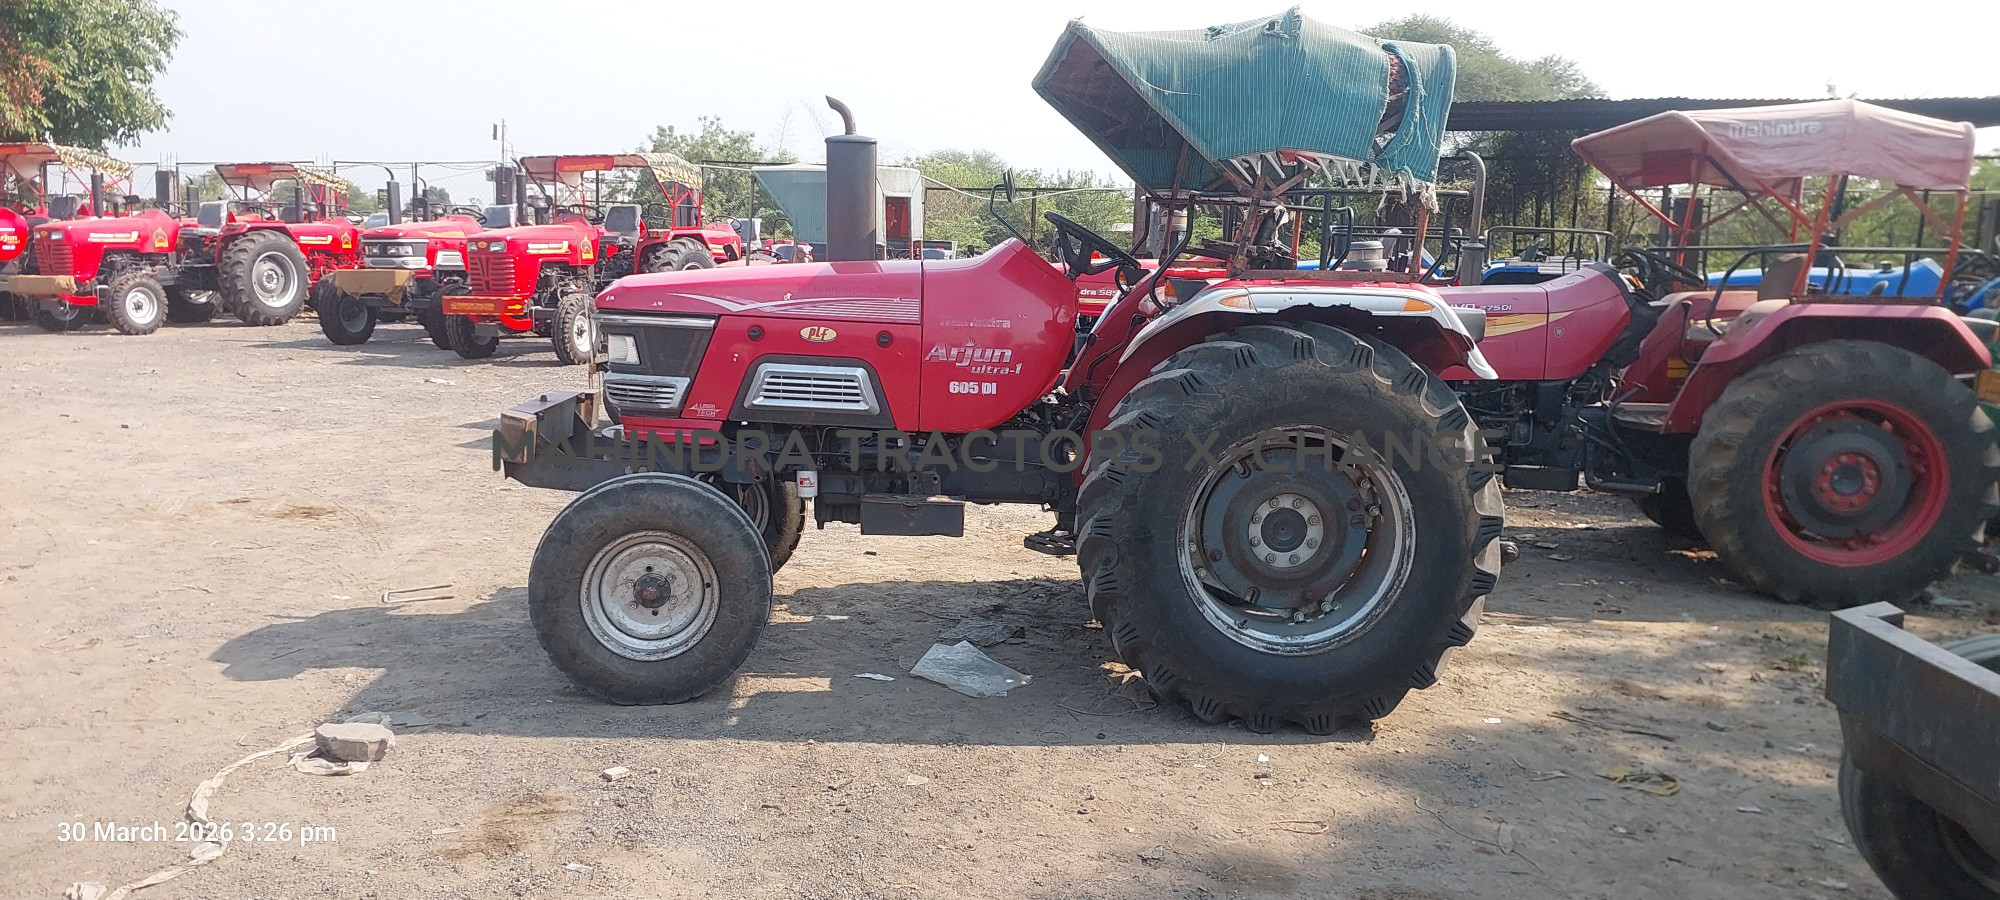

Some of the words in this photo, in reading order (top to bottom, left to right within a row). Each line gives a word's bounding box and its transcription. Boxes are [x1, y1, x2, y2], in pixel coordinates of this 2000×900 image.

[0, 234, 17, 242] rjun
[924, 342, 1013, 367] Arjun
[971, 363, 1023, 374] ultra-1
[949, 381, 979, 394] 605
[981, 382, 997, 394] DI
